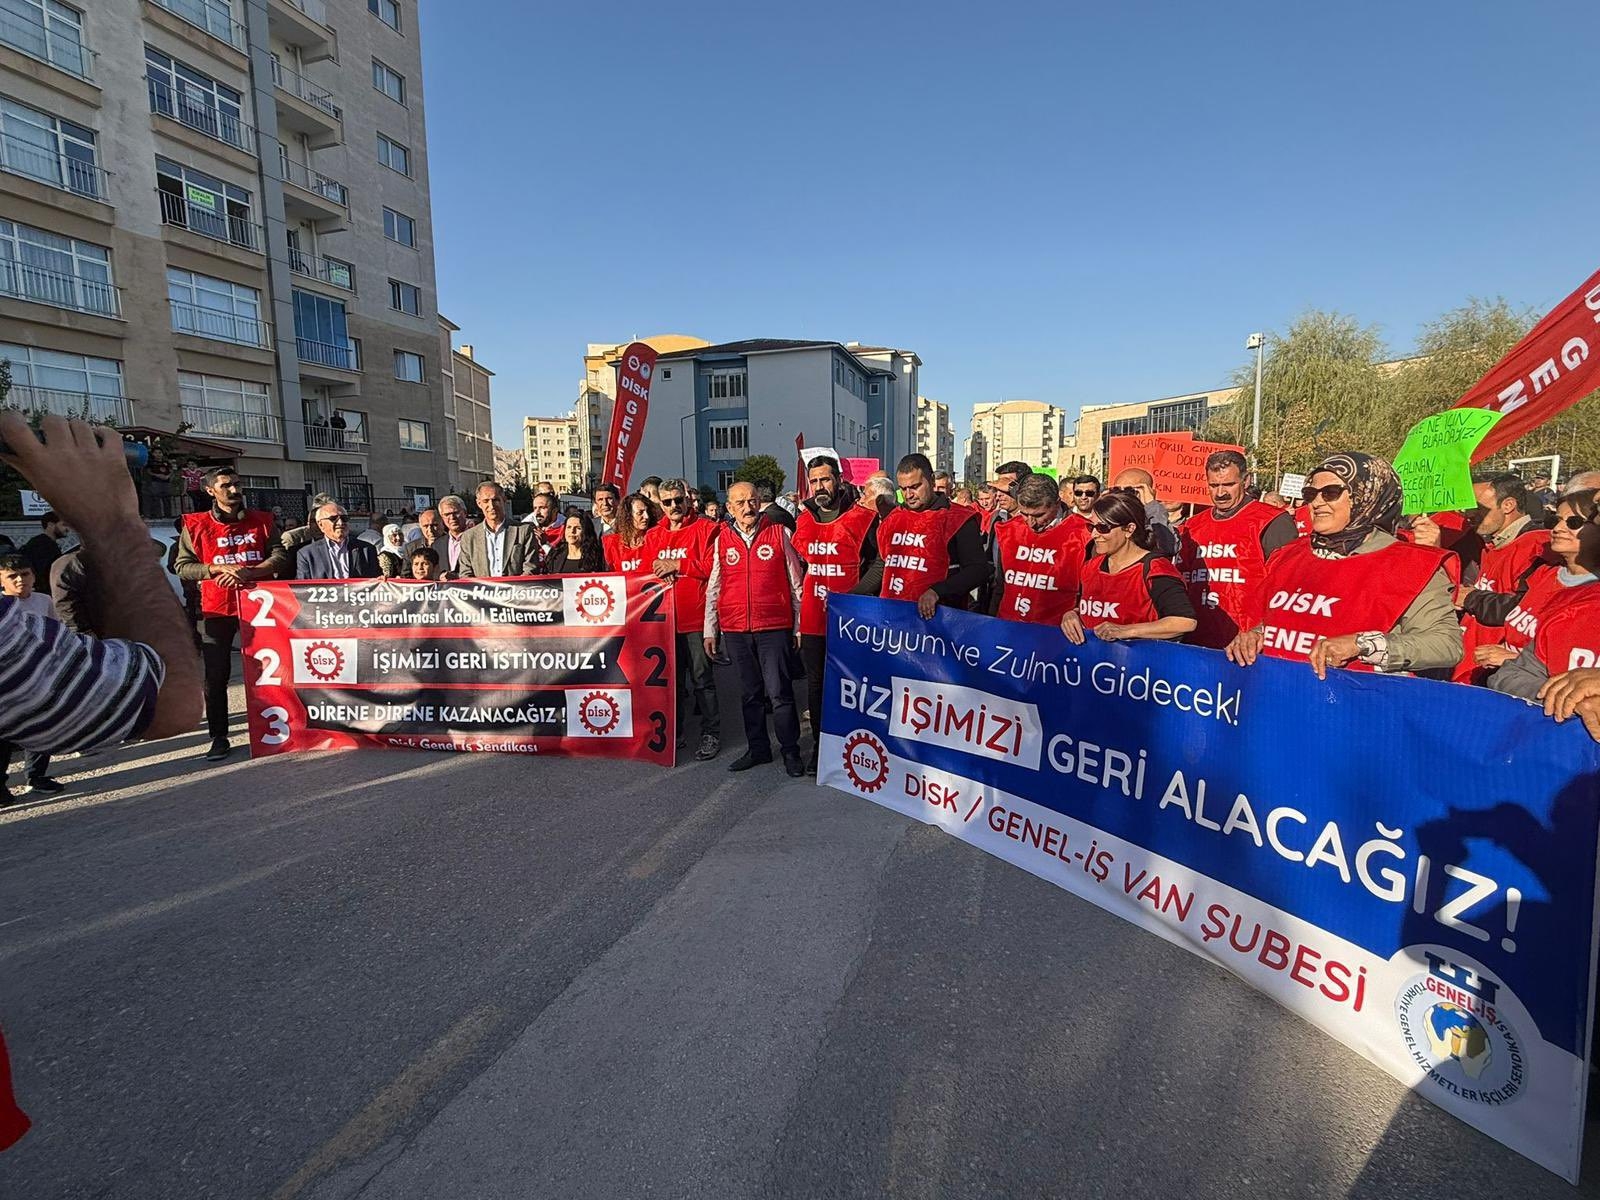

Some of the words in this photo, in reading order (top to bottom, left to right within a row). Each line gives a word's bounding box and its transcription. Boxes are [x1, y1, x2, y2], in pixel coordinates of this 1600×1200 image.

[1496, 336, 1589, 415] GEN
[621, 375, 649, 401] DİSK
[614, 399, 638, 479] GENEL
[1124, 454, 1156, 466] HAKLA
[216, 533, 257, 548] DİSK
[807, 539, 839, 556] DİSK
[891, 530, 928, 549] DİSK
[1196, 541, 1238, 559] DİSK
[213, 550, 263, 566] GENEL
[621, 557, 643, 572] DİS
[657, 546, 688, 560] DİSK
[1015, 543, 1057, 565] DİSK
[889, 573, 905, 595] İŞ
[1004, 569, 1059, 591] GENEL
[1191, 567, 1246, 584] GENEL
[306, 587, 339, 603] 223
[344, 583, 393, 607] İşçinin
[584, 594, 607, 606] DİSK
[814, 581, 828, 601] İŞ
[1201, 588, 1220, 610] İŞ
[248, 589, 277, 627] 2
[1014, 593, 1032, 617] İŞ
[1080, 596, 1121, 619] DİSK
[1269, 588, 1342, 618] DİSK
[316, 606, 354, 629] İşten
[359, 608, 440, 629] Çıkarılması
[444, 607, 486, 624] Kabul
[491, 606, 554, 624] Edilemez
[1263, 625, 1327, 655] ENE
[254, 647, 283, 687] 2
[312, 655, 336, 666] DİSK
[373, 648, 440, 674] İŞİMİZİ
[445, 648, 487, 670] GERİ
[493, 648, 595, 670] İSTİYORUZ
[643, 646, 669, 688] 2
[838, 615, 947, 656] Kayyum
[949, 641, 981, 668] ve
[987, 645, 1082, 688] Zulmü
[1091, 661, 1242, 726] Gidecek!
[307, 701, 369, 721] DİRENE
[374, 701, 434, 722] DİRENE
[439, 703, 557, 724] KAZANACAĞIZ
[588, 705, 611, 717] DİSK
[260, 706, 291, 745] 3
[647, 711, 668, 753] 3
[420, 738, 457, 751] Genel
[477, 740, 538, 753] Sendikası
[852, 751, 880, 772] DİSK
[840, 676, 891, 721] BİZ
[900, 686, 1024, 758] İŞİMİZİ
[1047, 733, 1148, 800] GERİ
[1158, 770, 1523, 954] ALACAĞIZ!
[904, 773, 960, 814] DİSK
[988, 805, 1115, 884] GENEL-İŞ
[1123, 862, 1195, 923] VAN
[1200, 903, 1369, 1012] ŞUBESİ
[1399, 981, 1428, 1014] TÜRKİYE
[1425, 976, 1498, 1026] GENEL-İŞ
[1399, 1013, 1418, 1051] GENEL
[1412, 1051, 1478, 1101] HİZMETLER
